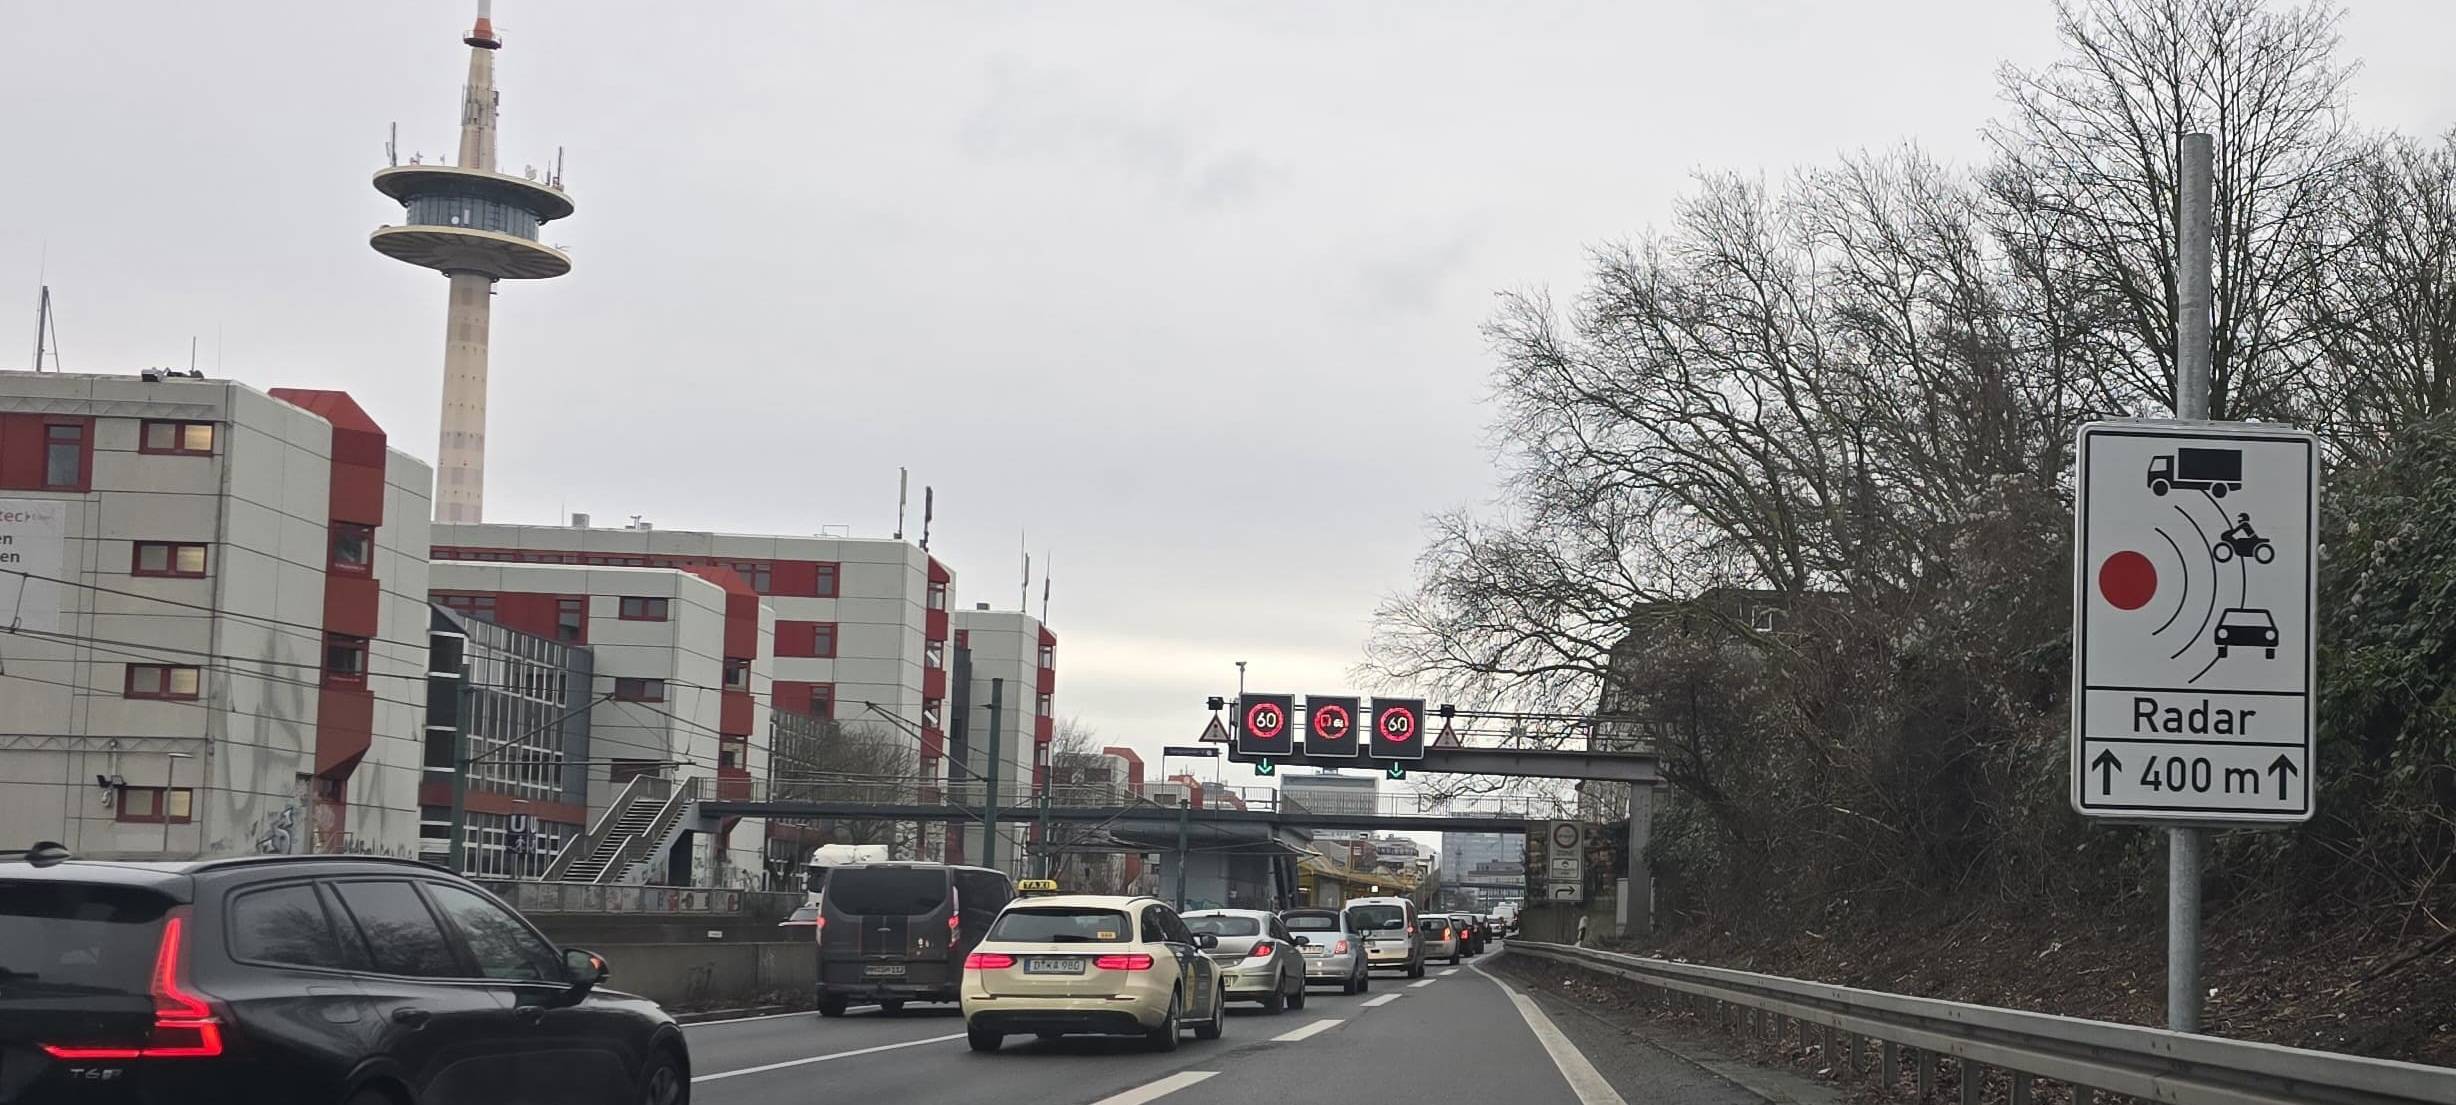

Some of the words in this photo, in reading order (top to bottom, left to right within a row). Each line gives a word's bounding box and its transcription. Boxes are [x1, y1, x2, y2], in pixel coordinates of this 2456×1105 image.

[0, 535, 13, 545] n
[1256, 712, 1277, 728] 60
[1387, 716, 1408, 732] 60
[2134, 697, 2257, 735] Radar
[2140, 756, 2212, 793] 400
[2225, 768, 2260, 794] m
[511, 815, 526, 833] U
[1023, 881, 1050, 889] TAXI
